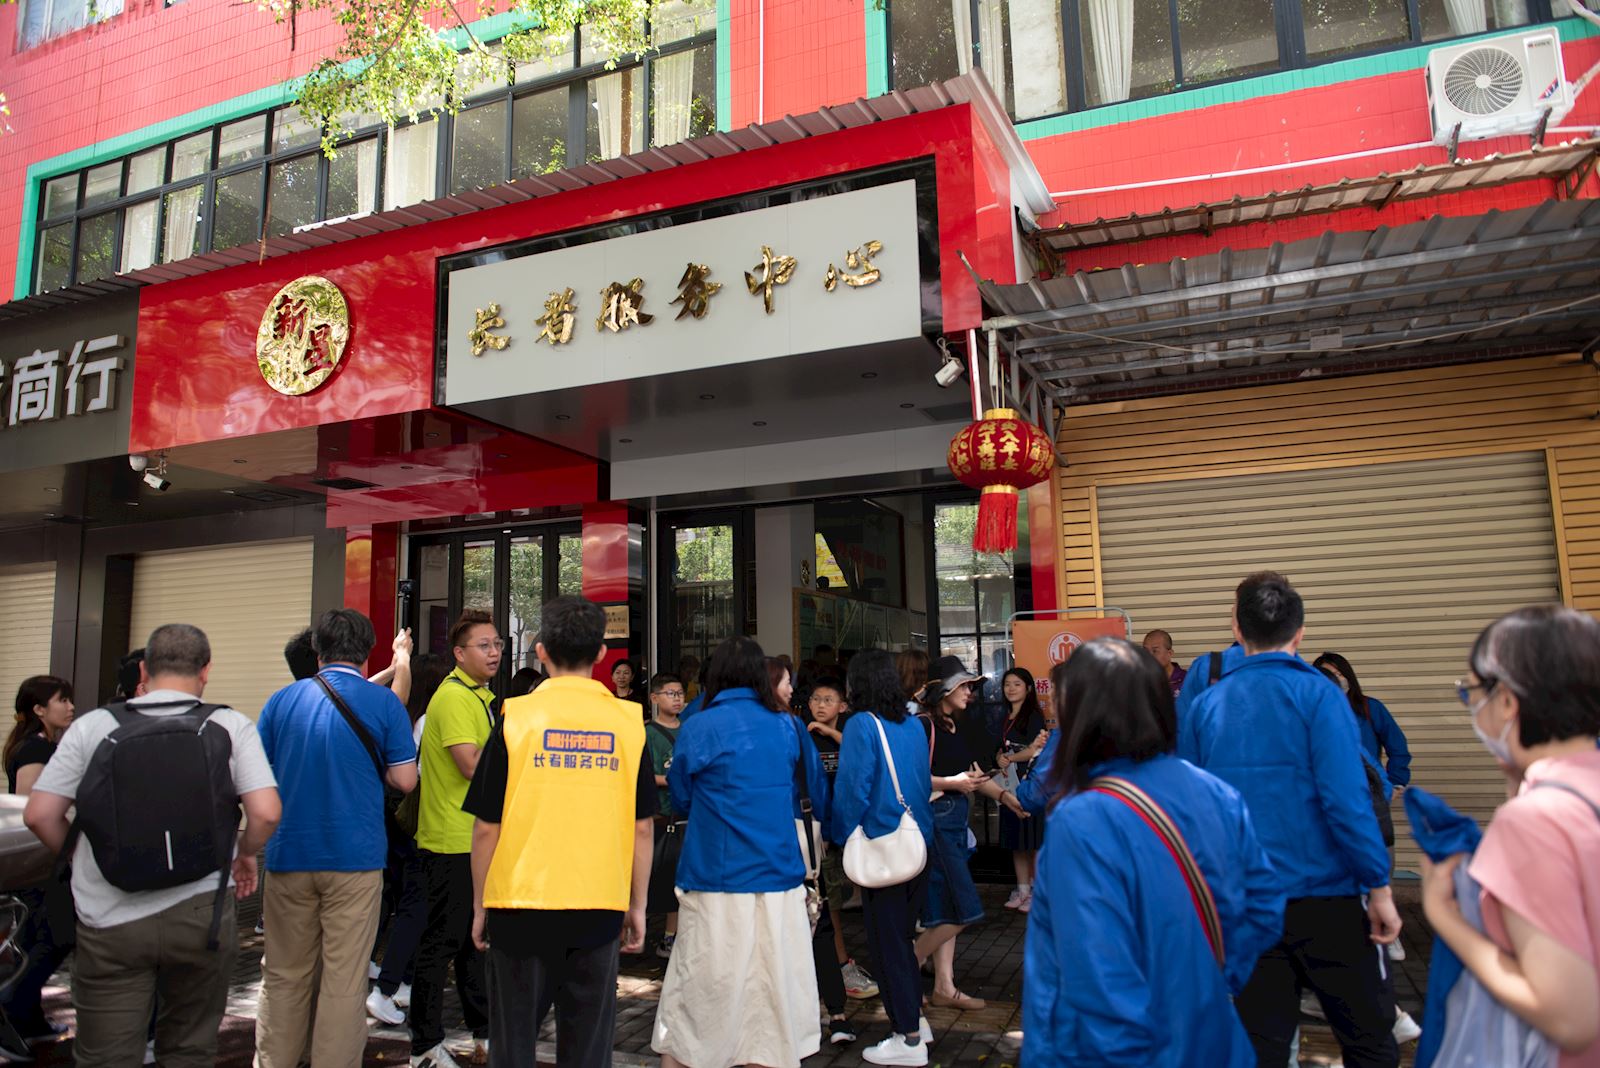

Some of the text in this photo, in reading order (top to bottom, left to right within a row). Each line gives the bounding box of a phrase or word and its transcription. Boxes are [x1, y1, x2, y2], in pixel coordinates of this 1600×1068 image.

[467, 240, 884, 357] 长者服务中心
[0, 334, 123, 428] 商行
[534, 752, 619, 771] 长者服务中心
